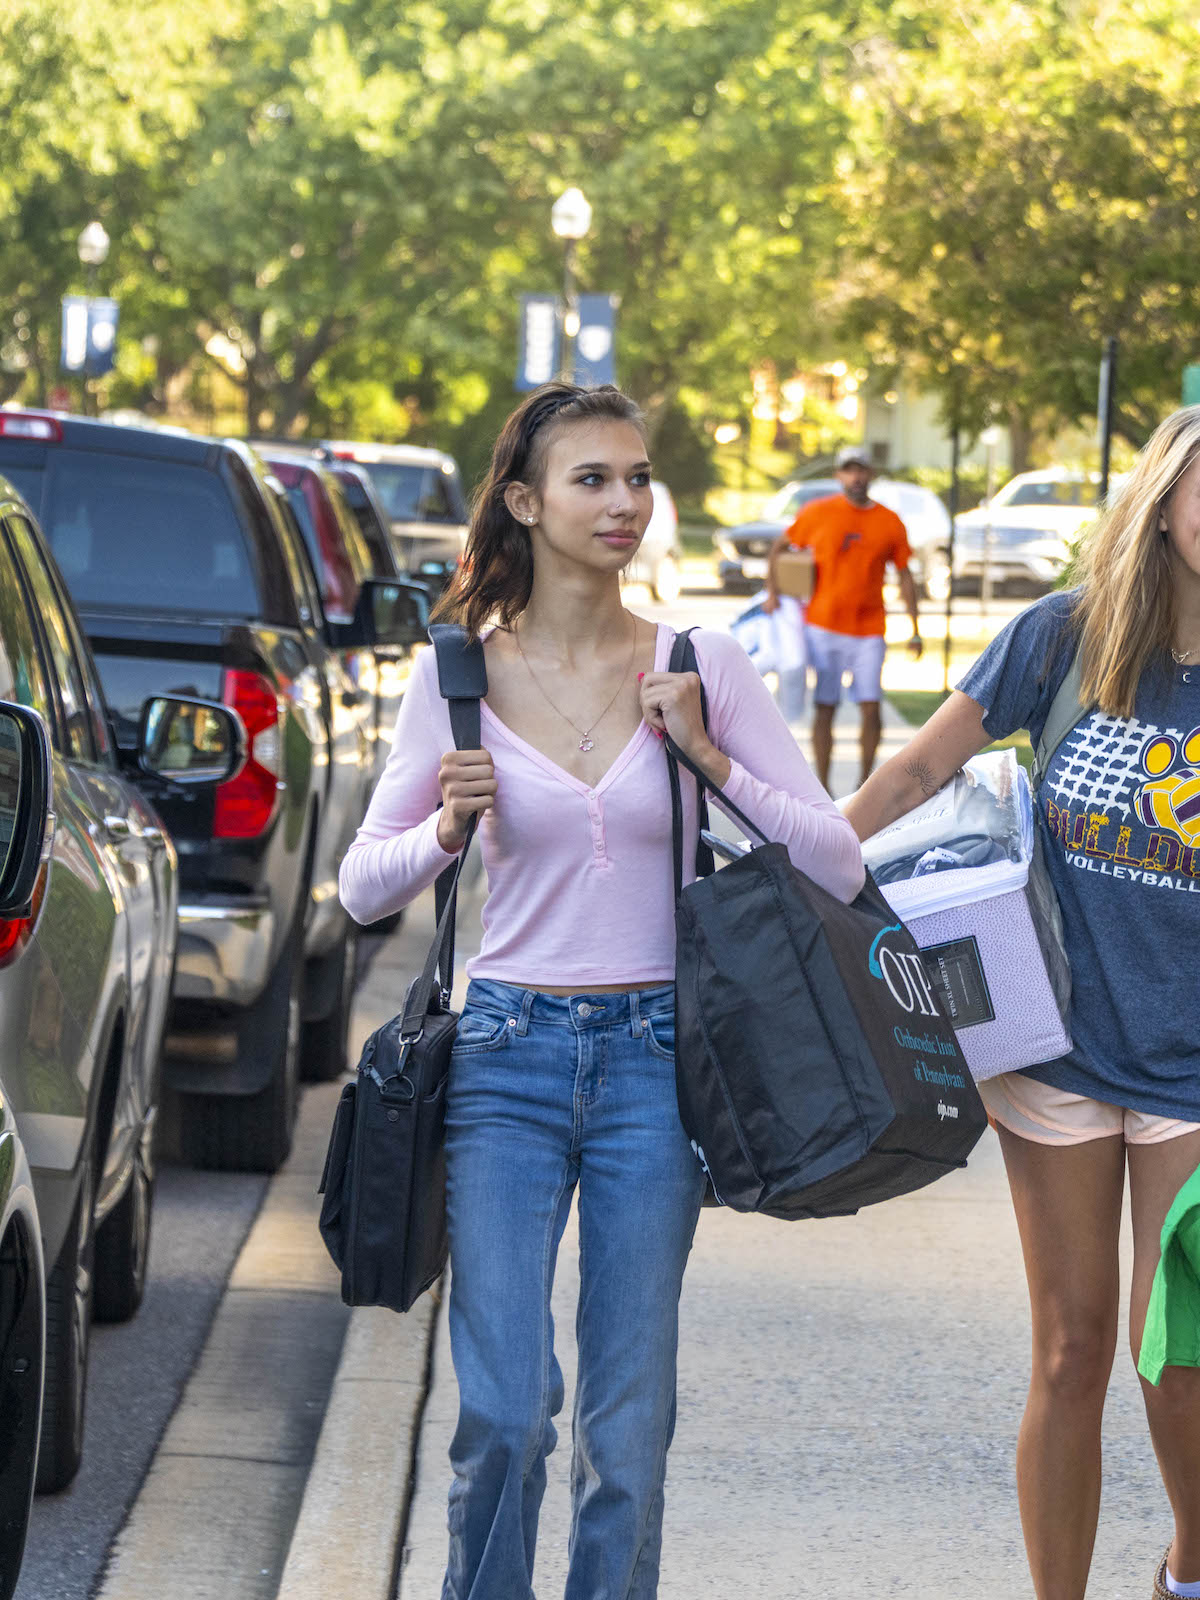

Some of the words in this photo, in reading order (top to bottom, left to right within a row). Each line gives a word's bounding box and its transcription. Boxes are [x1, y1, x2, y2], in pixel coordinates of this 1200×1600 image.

[1064, 850, 1200, 893] VOLLEYBALL
[938, 957, 946, 969] SET
[879, 946, 940, 1016] OIP
[941, 970, 952, 990] SHEET
[946, 990, 954, 1000] XL
[948, 1000, 958, 1018] TWIN
[914, 1059, 923, 1081] of
[937, 1099, 959, 1121] oip.com
